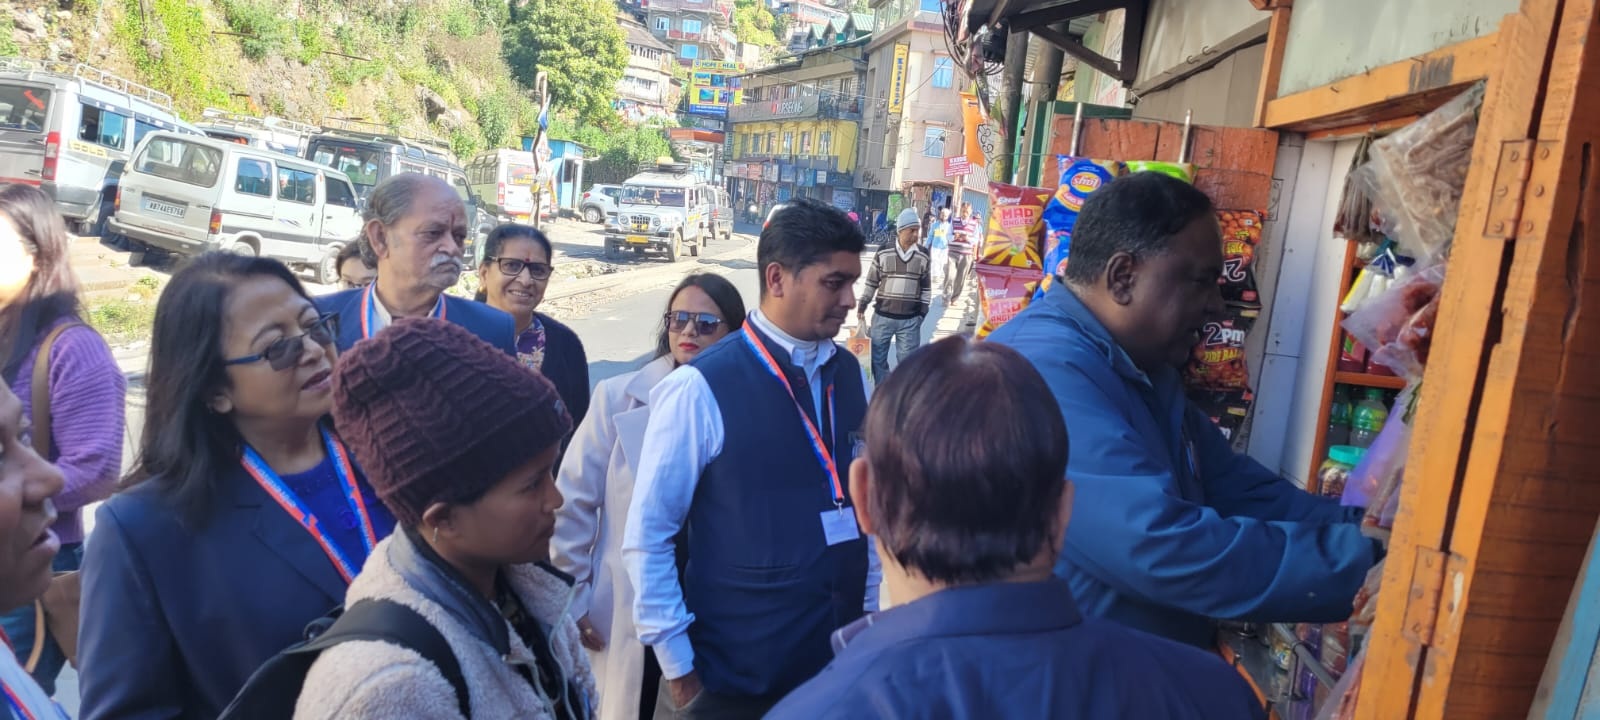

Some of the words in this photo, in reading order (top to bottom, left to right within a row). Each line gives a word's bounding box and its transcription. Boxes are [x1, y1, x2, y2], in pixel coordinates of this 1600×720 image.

[701, 61, 717, 69] HOPE
[722, 62, 736, 70] HEAL
[1001, 207, 1034, 219] MAD
[1002, 218, 1035, 226] ANGLES
[1203, 322, 1245, 346] 2pm
